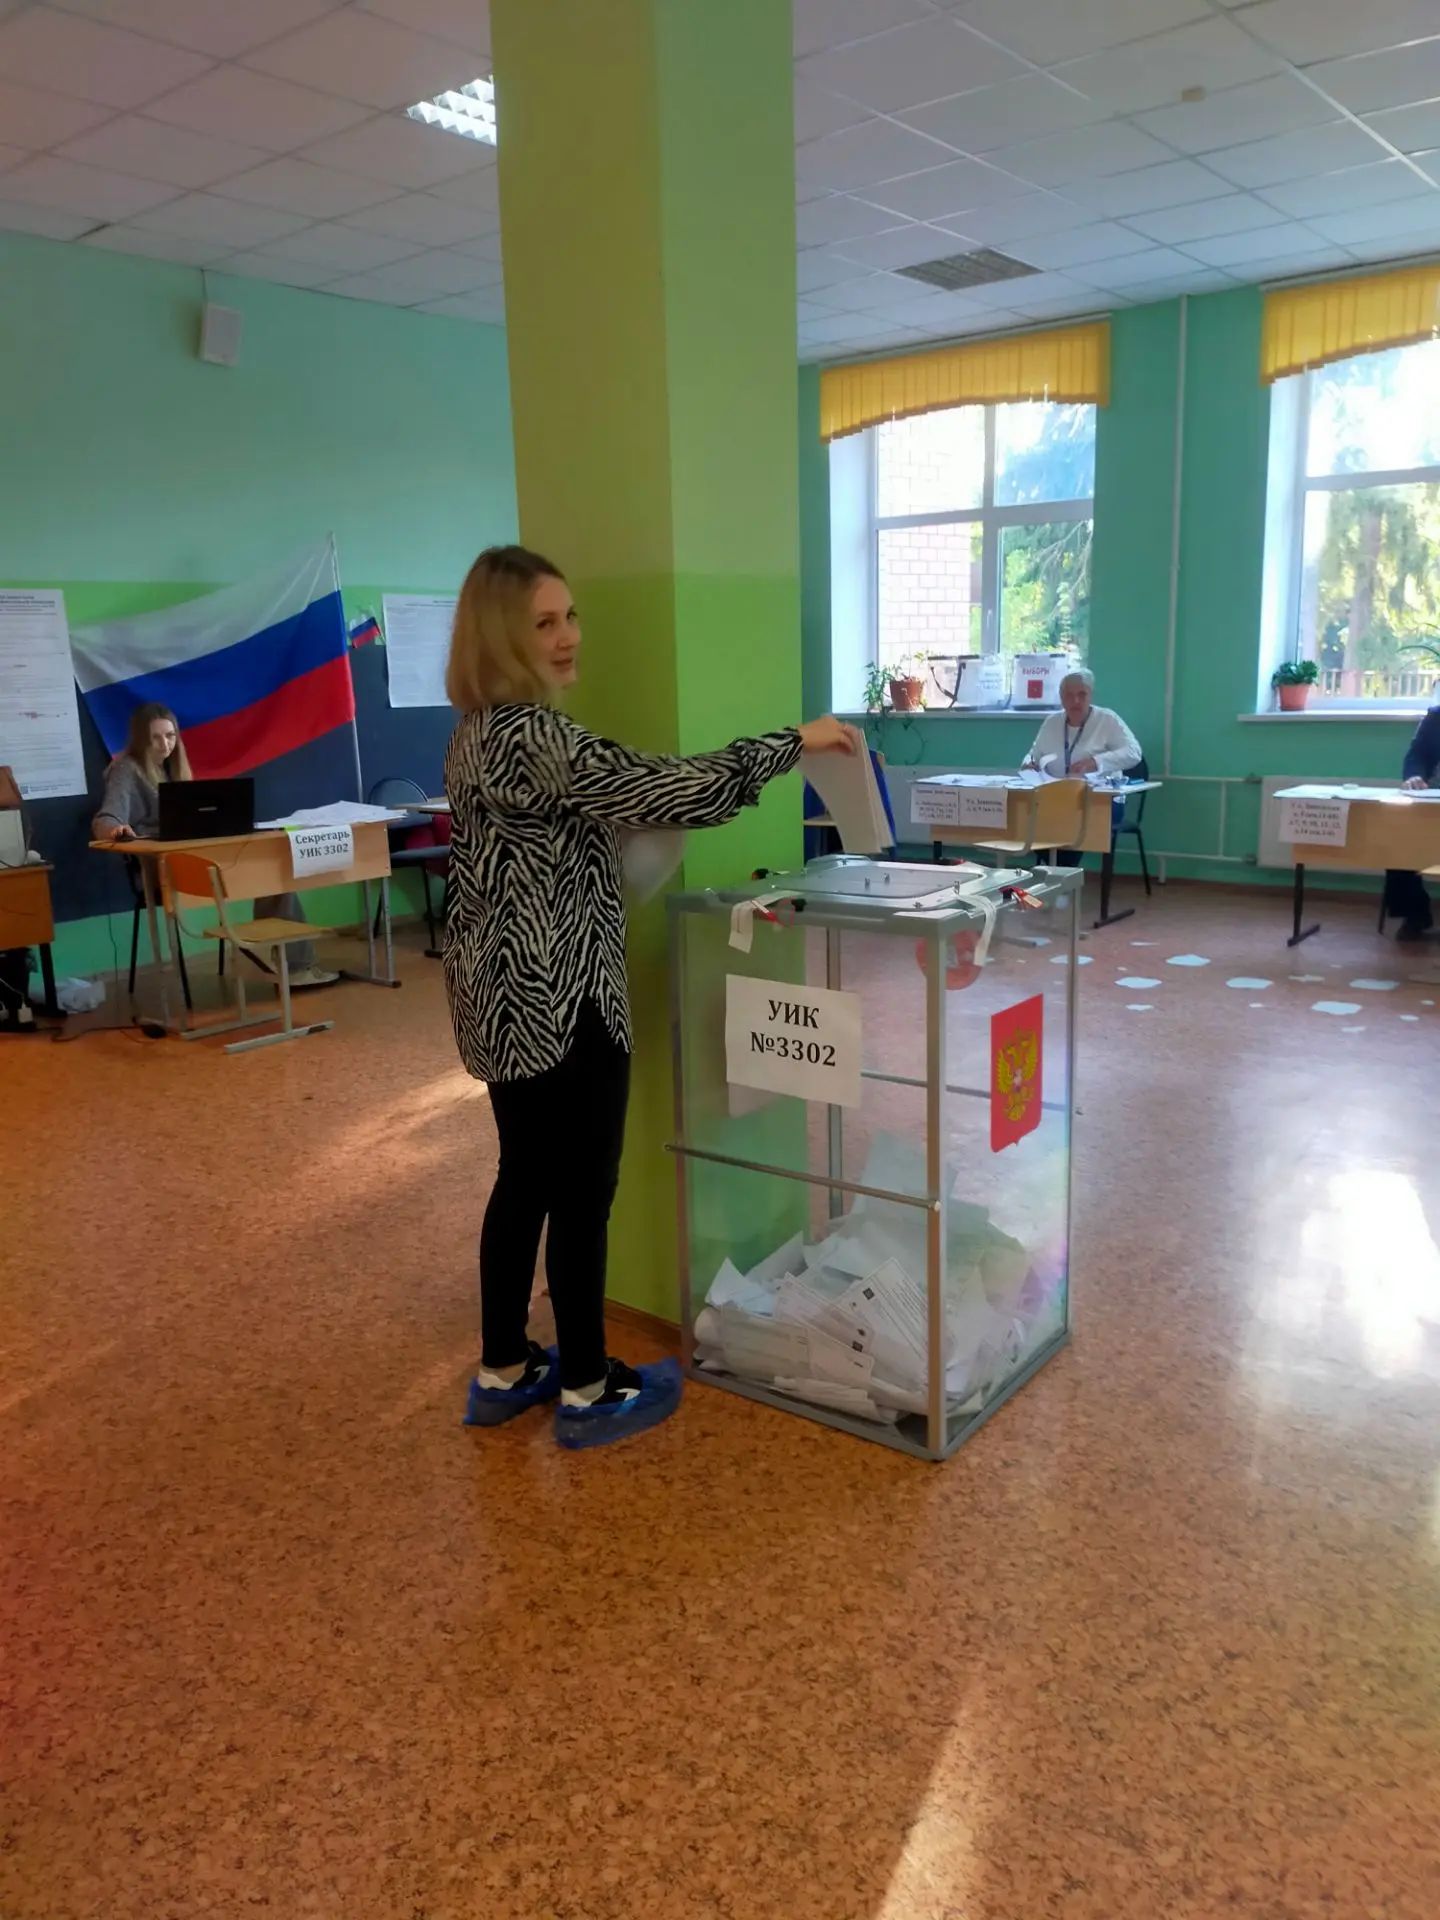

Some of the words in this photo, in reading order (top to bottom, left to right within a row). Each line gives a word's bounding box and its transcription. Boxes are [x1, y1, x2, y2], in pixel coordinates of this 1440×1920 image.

[295, 831, 350, 845] Секретарь
[300, 847, 322, 859] УИК
[323, 843, 349, 855] 3302
[768, 999, 820, 1030] УИК
[750, 1030, 836, 1068] №3302
